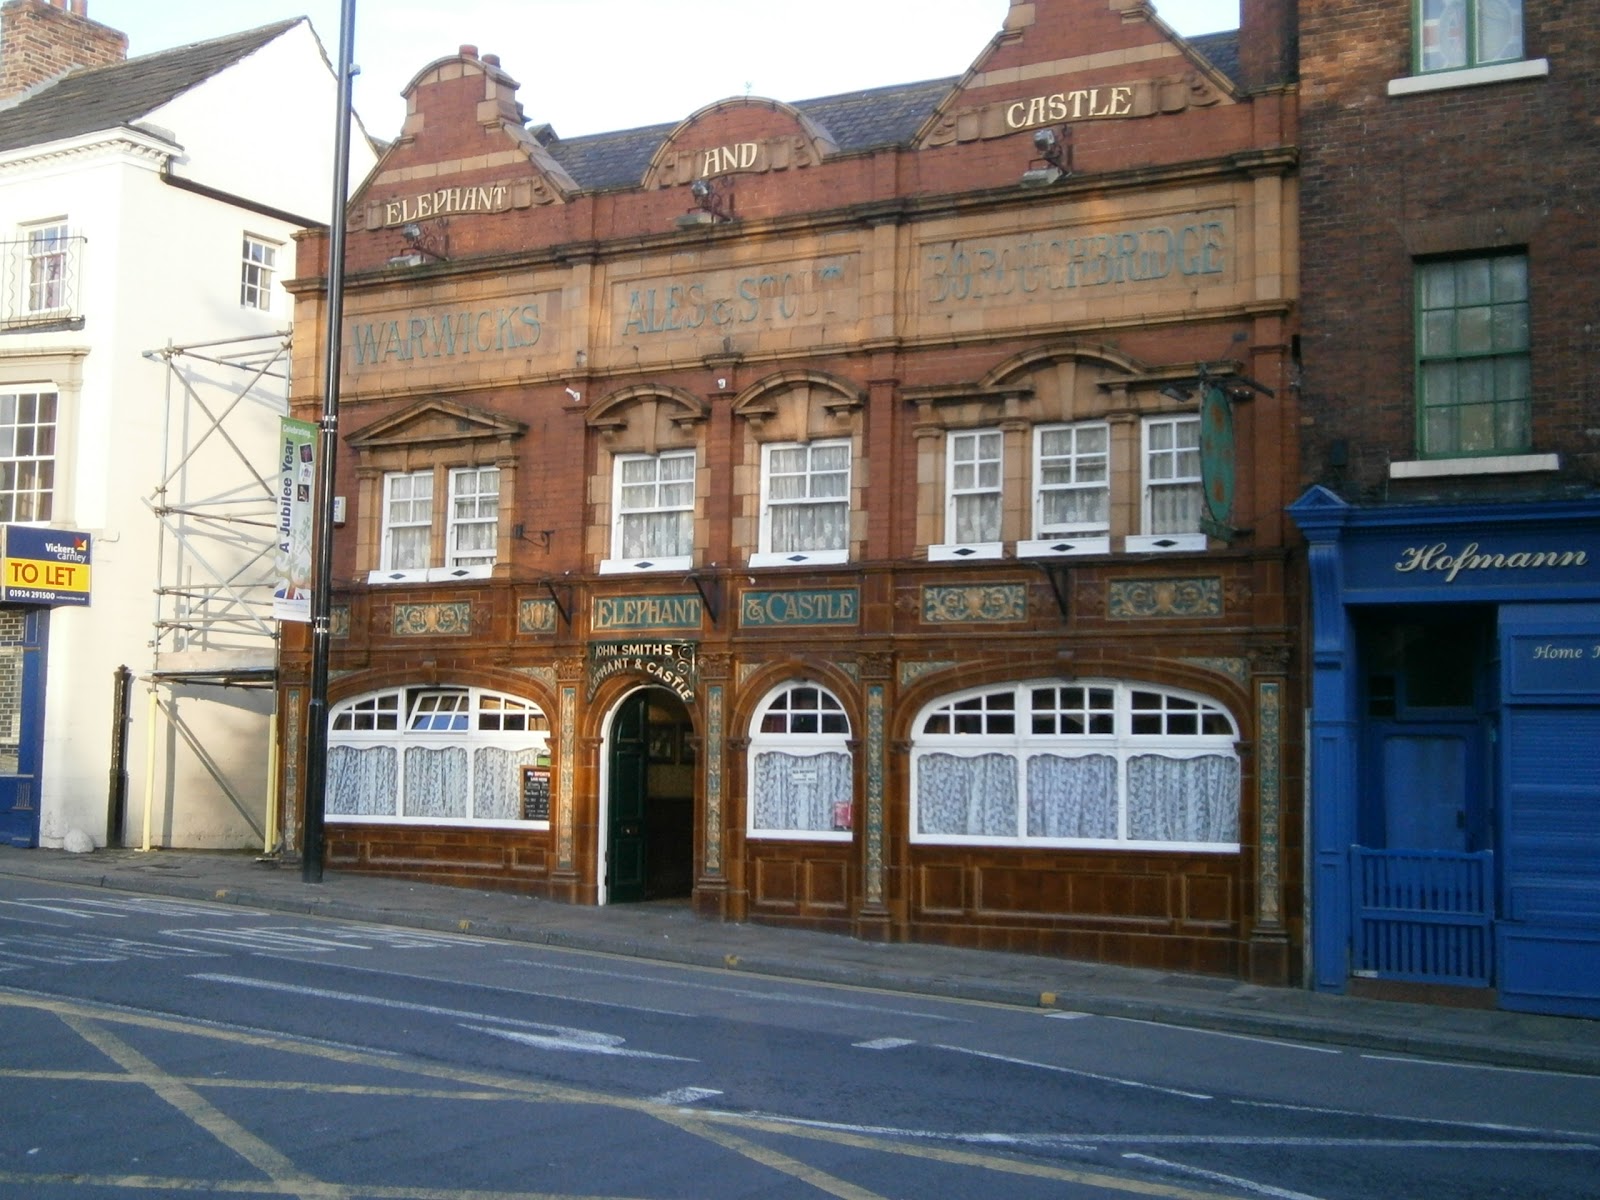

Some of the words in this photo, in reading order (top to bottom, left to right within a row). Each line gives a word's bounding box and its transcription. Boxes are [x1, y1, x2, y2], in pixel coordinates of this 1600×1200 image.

[1007, 87, 1131, 129] CASTLE
[702, 143, 758, 177] AND
[386, 186, 507, 225] ELEPHANT
[622, 284, 706, 336] ALES
[352, 304, 542, 366] WARWICKS
[281, 437, 294, 472] Year
[280, 477, 293, 537] Jubilee
[45, 542, 75, 554] Vickers
[57, 551, 87, 563] carnley
[279, 542, 290, 553] A
[1395, 542, 1589, 582] Hofmann
[11, 562, 39, 584] TO
[46, 565, 76, 586] LET
[9, 589, 30, 598] 01924
[31, 590, 56, 600] 291500
[765, 592, 854, 624] CASTLE
[597, 598, 699, 628] ELEPHANT
[595, 644, 618, 657] JOHN
[622, 644, 674, 656] SMITHS
[1533, 644, 1583, 659] Home
[634, 658, 643, 670] &
[646, 662, 693, 701] CASTLE
